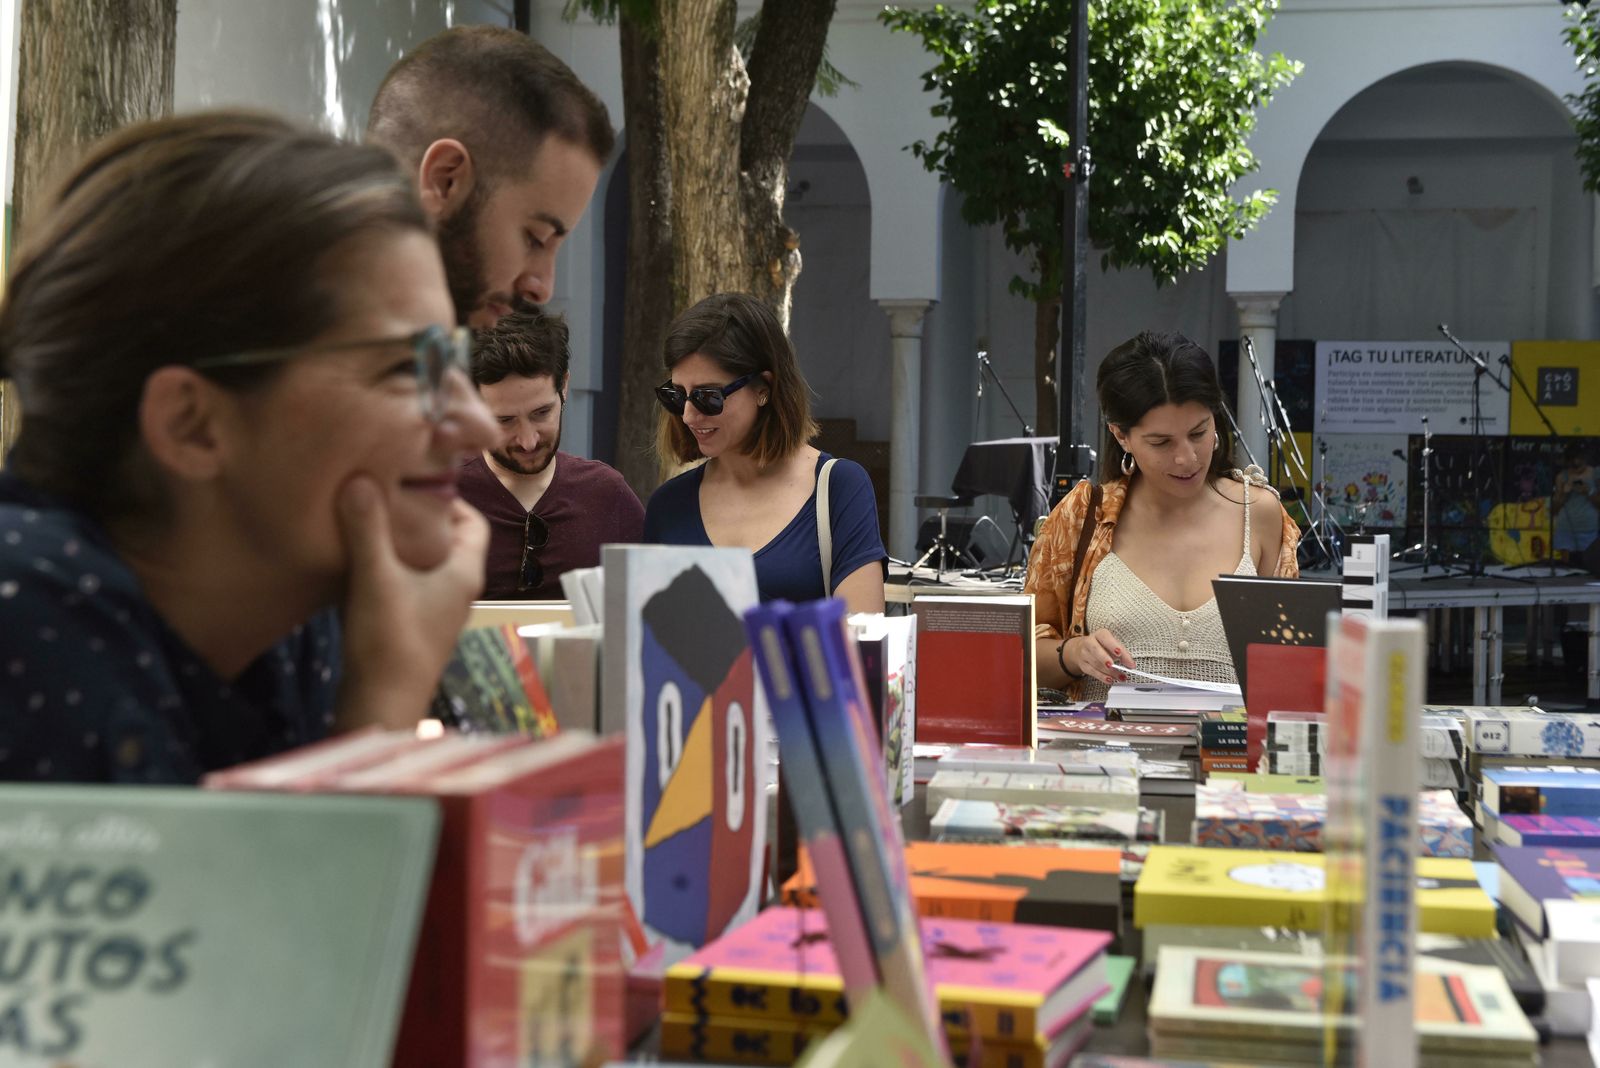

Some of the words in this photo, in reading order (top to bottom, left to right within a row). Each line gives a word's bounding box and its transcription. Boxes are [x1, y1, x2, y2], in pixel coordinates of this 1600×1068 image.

[1328, 350, 1363, 366] ¡TAG
[1367, 350, 1388, 364] TU
[1392, 350, 1490, 364] LITERATURA!
[1482, 731, 1502, 740] 012
